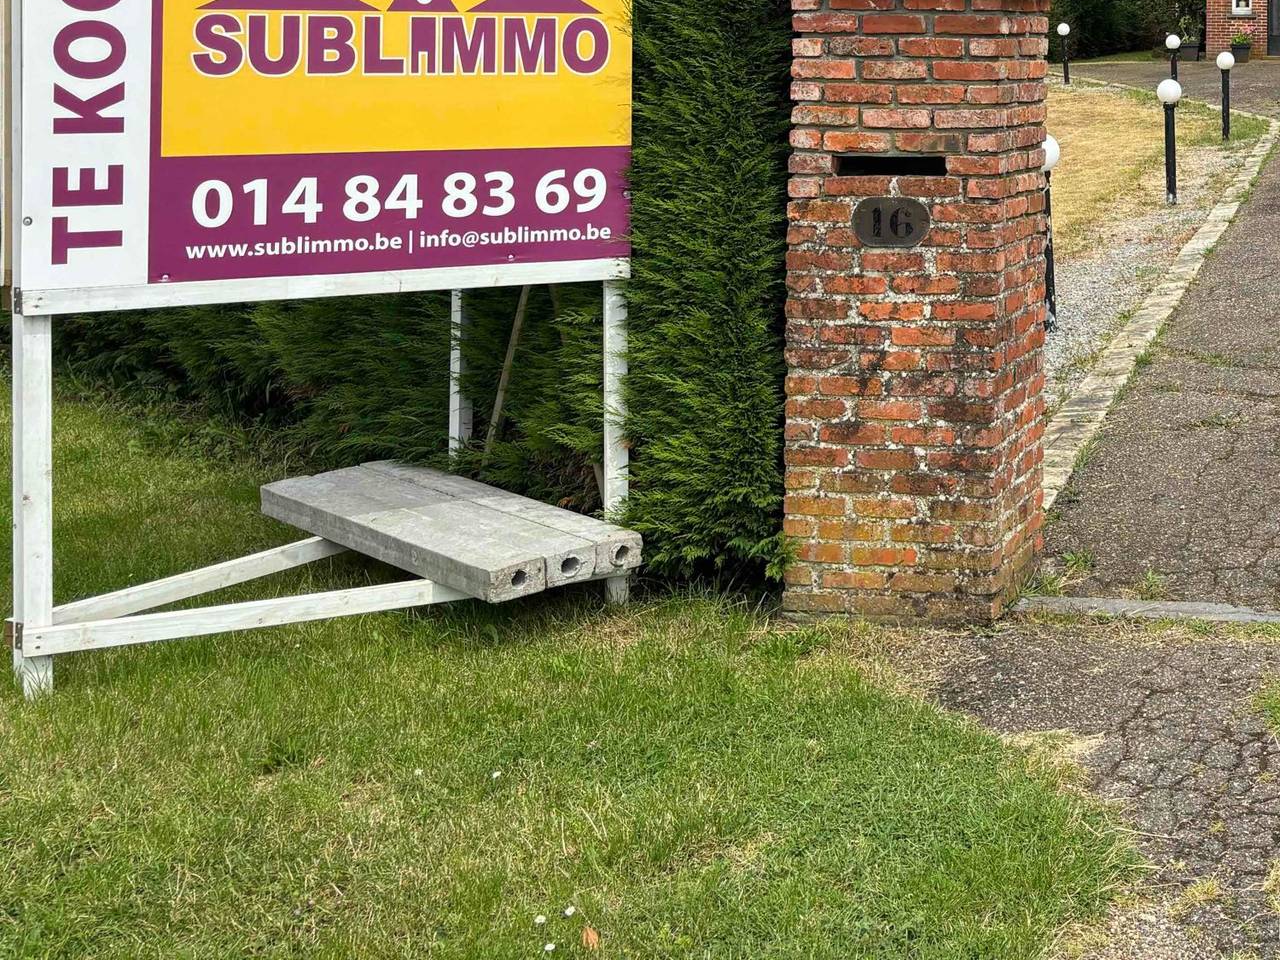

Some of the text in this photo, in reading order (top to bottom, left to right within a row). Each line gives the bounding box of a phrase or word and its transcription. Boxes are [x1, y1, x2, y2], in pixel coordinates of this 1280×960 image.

[191, 13, 611, 77] SUBLIMMO
[51, 164, 125, 265] TE
[191, 168, 607, 228] 014 84 83 69
[872, 207, 914, 238] 16
[186, 232, 402, 259] www.sublimmo.be
[419, 224, 611, 250] info@sublimmo.be
